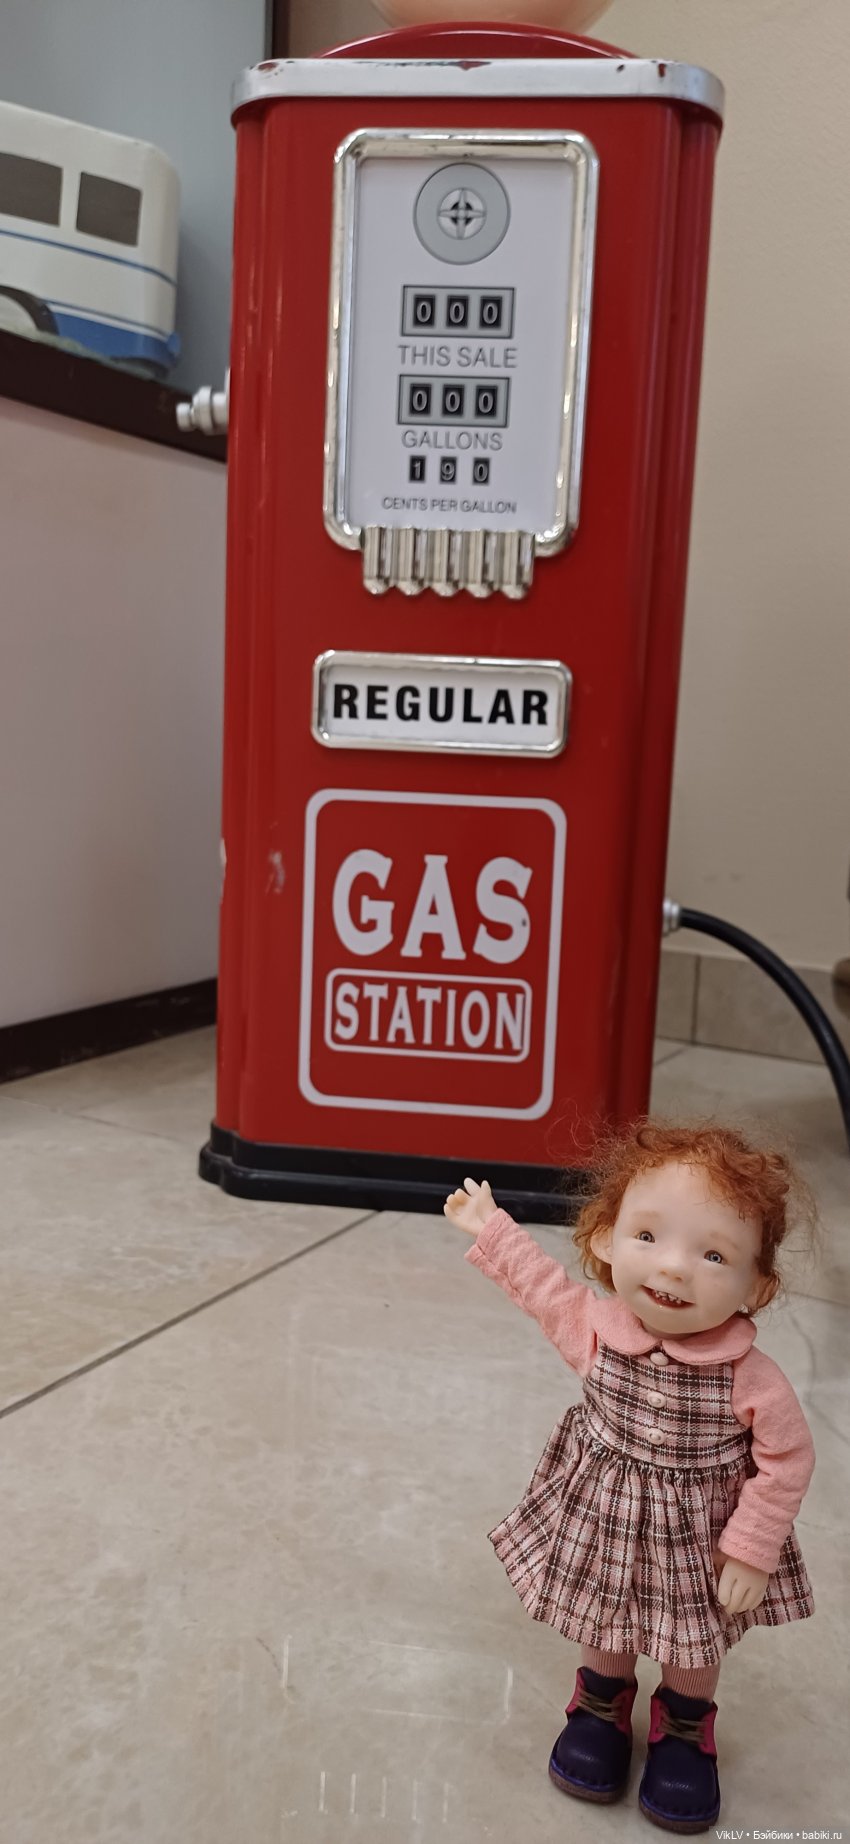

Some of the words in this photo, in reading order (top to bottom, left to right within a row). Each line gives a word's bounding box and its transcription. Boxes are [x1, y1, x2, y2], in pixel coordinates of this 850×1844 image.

[397, 344, 451, 368] THIS
[456, 346, 518, 369] SALE
[401, 429, 503, 452] GALLONS
[382, 496, 428, 512] CENTS
[430, 497, 459, 513] PER
[460, 499, 517, 515] GALLON
[332, 683, 549, 726] REGULAR
[331, 848, 534, 965] GAS
[333, 982, 526, 1051] STATION
